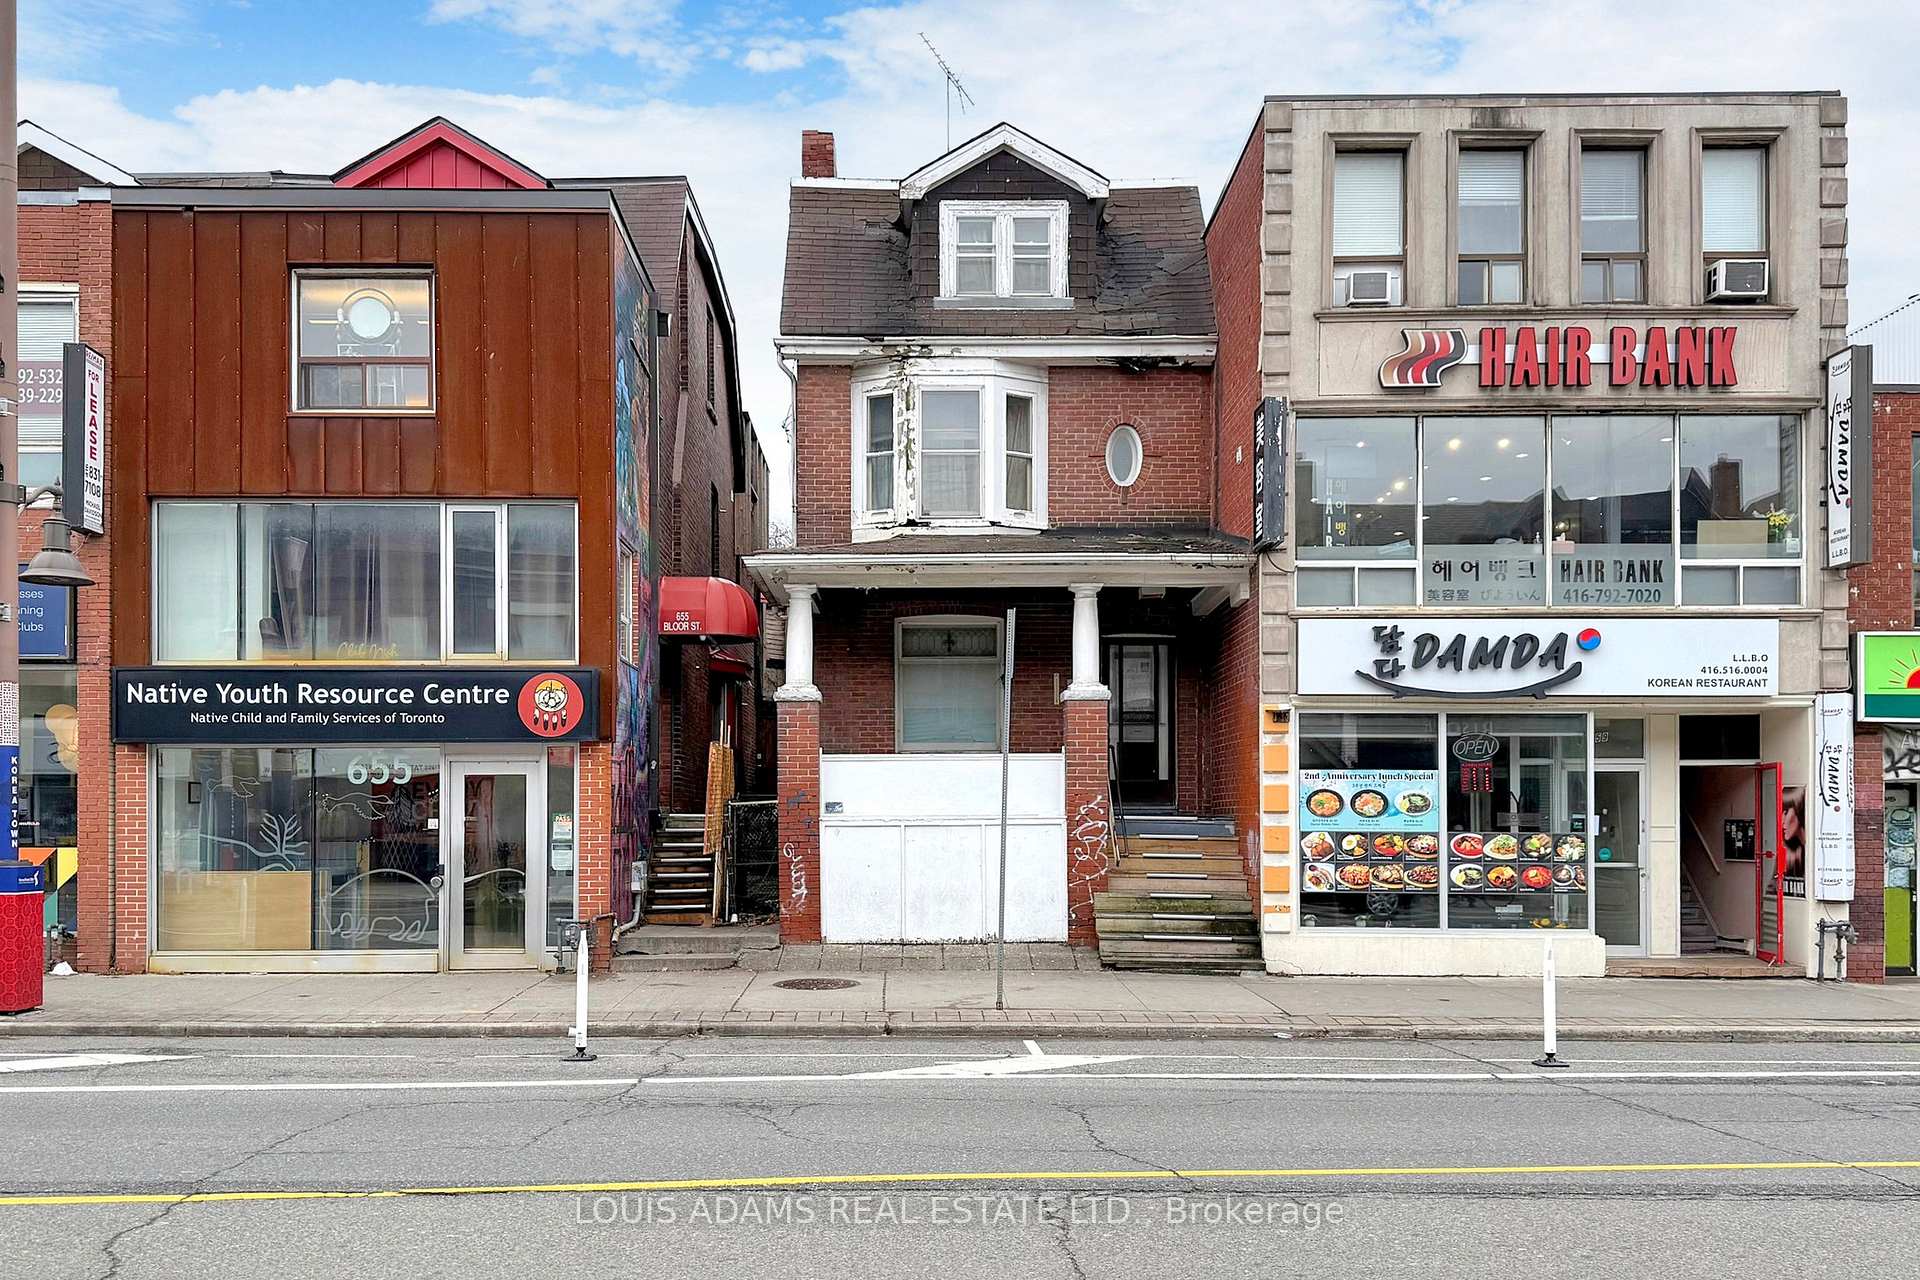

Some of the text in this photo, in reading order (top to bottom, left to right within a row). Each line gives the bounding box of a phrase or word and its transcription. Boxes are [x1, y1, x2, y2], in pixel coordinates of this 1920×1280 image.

[1478, 326, 1739, 388] HAIR BANK
[88, 369, 99, 383] FOR
[89, 382, 98, 461] LEASE
[1837, 419, 1849, 496] DAMDA
[85, 480, 101, 498] 7108
[1432, 560, 1537, 583] 헤어뱅크
[1560, 560, 1664, 583] HAIR BANK
[1563, 588, 1661, 604] 416-792-7020
[663, 621, 702, 631] BLOOR ST.
[676, 612, 689, 621] 655
[1372, 625, 1405, 679] 담다
[1412, 632, 1569, 672] DAMDA
[1733, 654, 1768, 662] L.L.B.O
[1700, 666, 1768, 675] 416.516.0004
[126, 682, 510, 704] Native Youth Resource Centre
[1647, 678, 1768, 688] KOREAN RESTAURANT
[190, 711, 445, 726] Native Child and Family Services of Toronto
[1455, 740, 1495, 755] OPEN
[347, 755, 412, 785] 655
[1404, 772, 1434, 782] Special
[1828, 756, 1840, 803] DAMDA
[10, 809, 18, 848] TOWN
